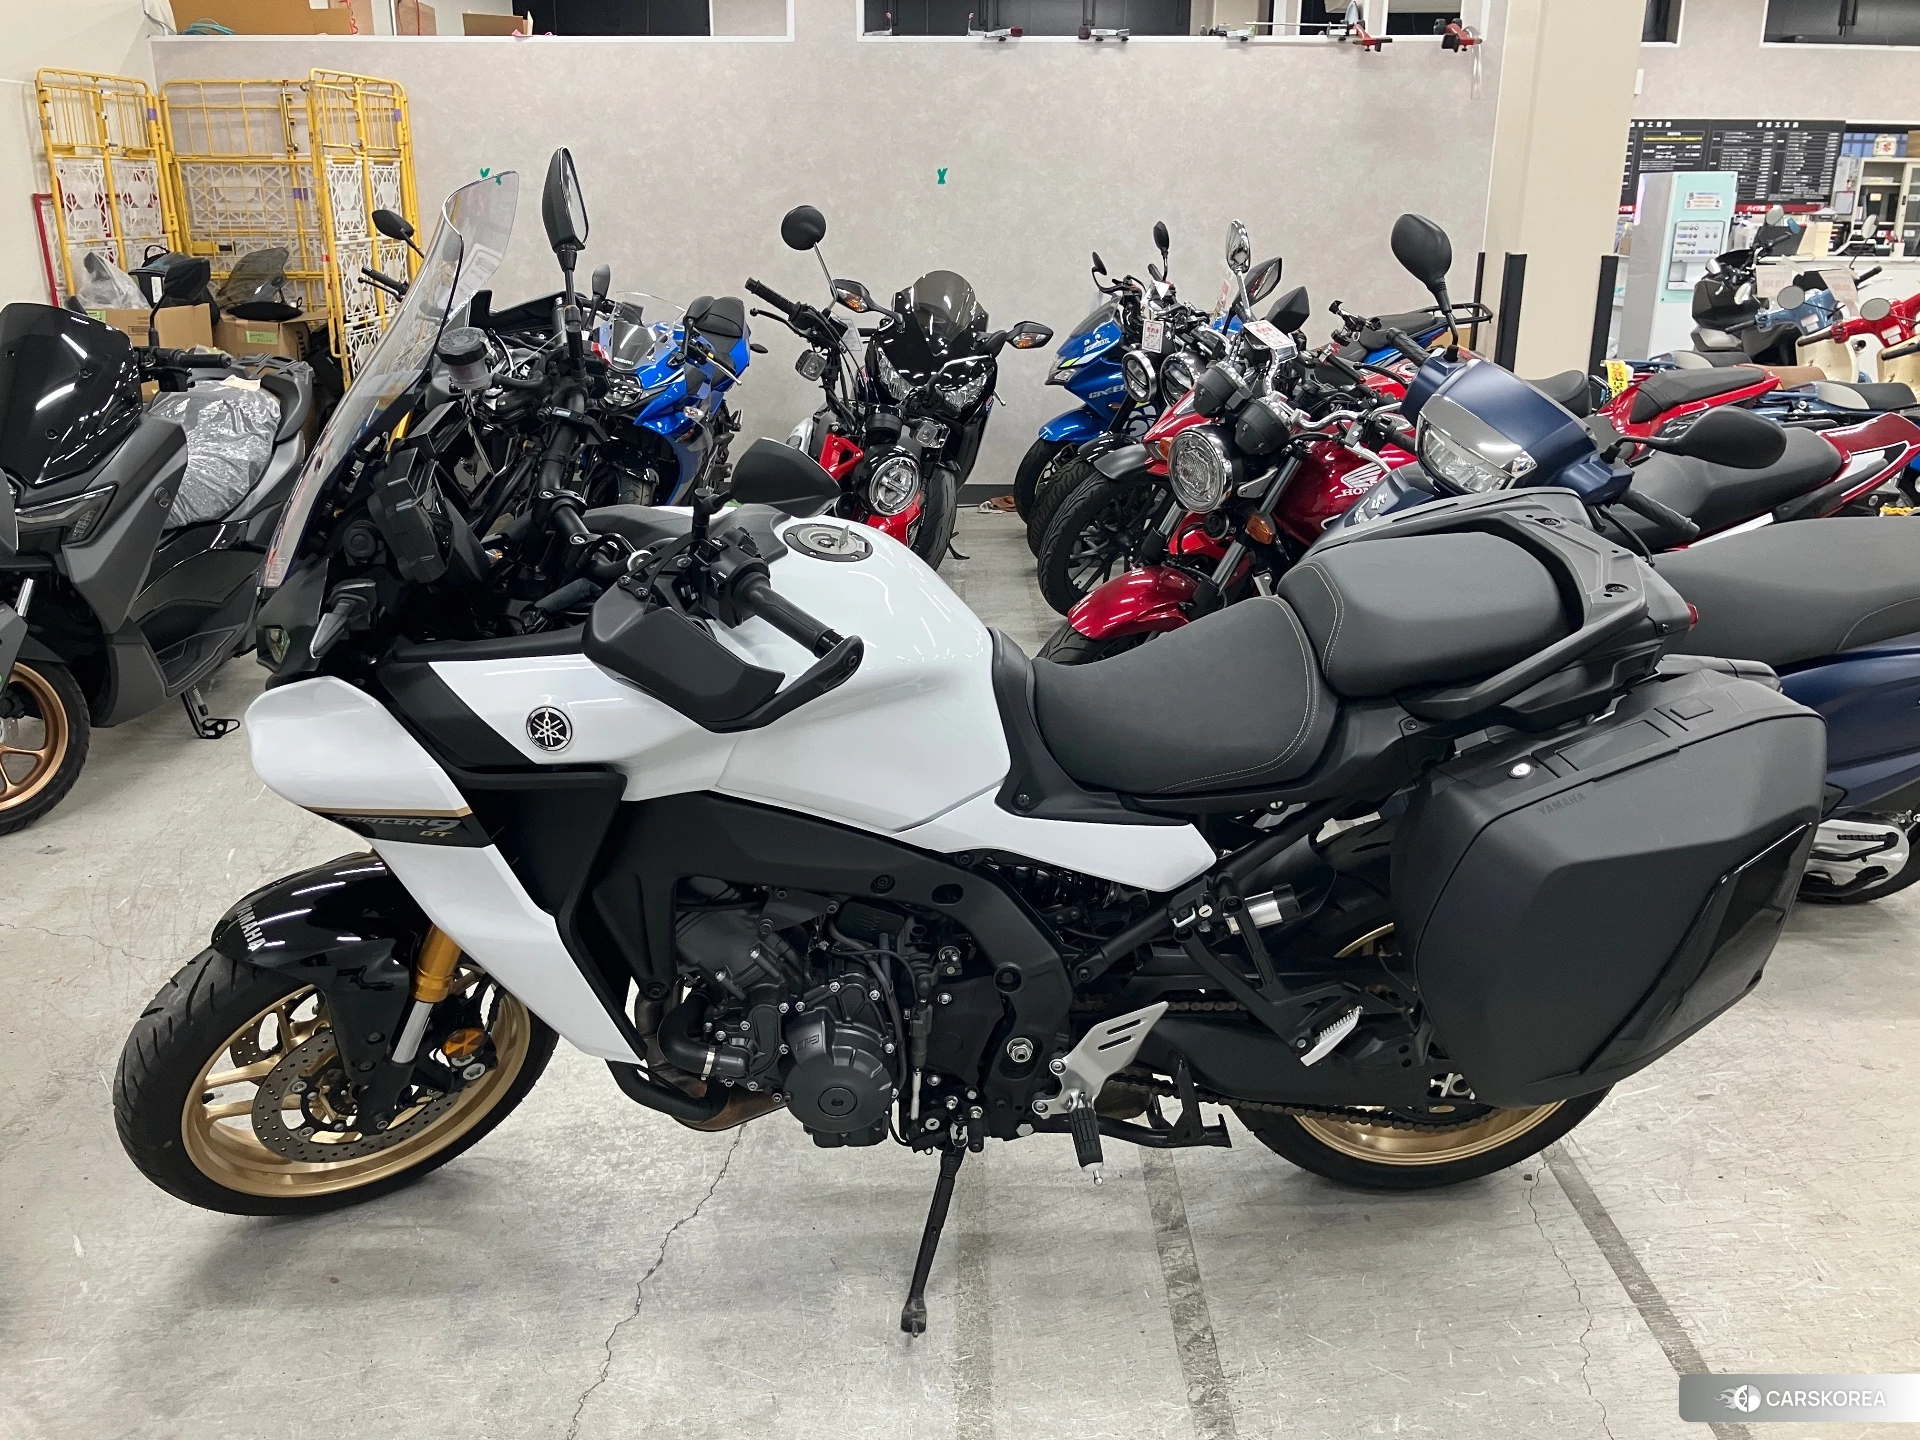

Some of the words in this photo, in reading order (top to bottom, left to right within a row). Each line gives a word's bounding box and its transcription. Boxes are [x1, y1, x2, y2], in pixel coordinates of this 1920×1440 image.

[1537, 793, 1587, 816] YAMAHA
[419, 830, 453, 838] GT
[236, 903, 267, 952] YAMAHA
